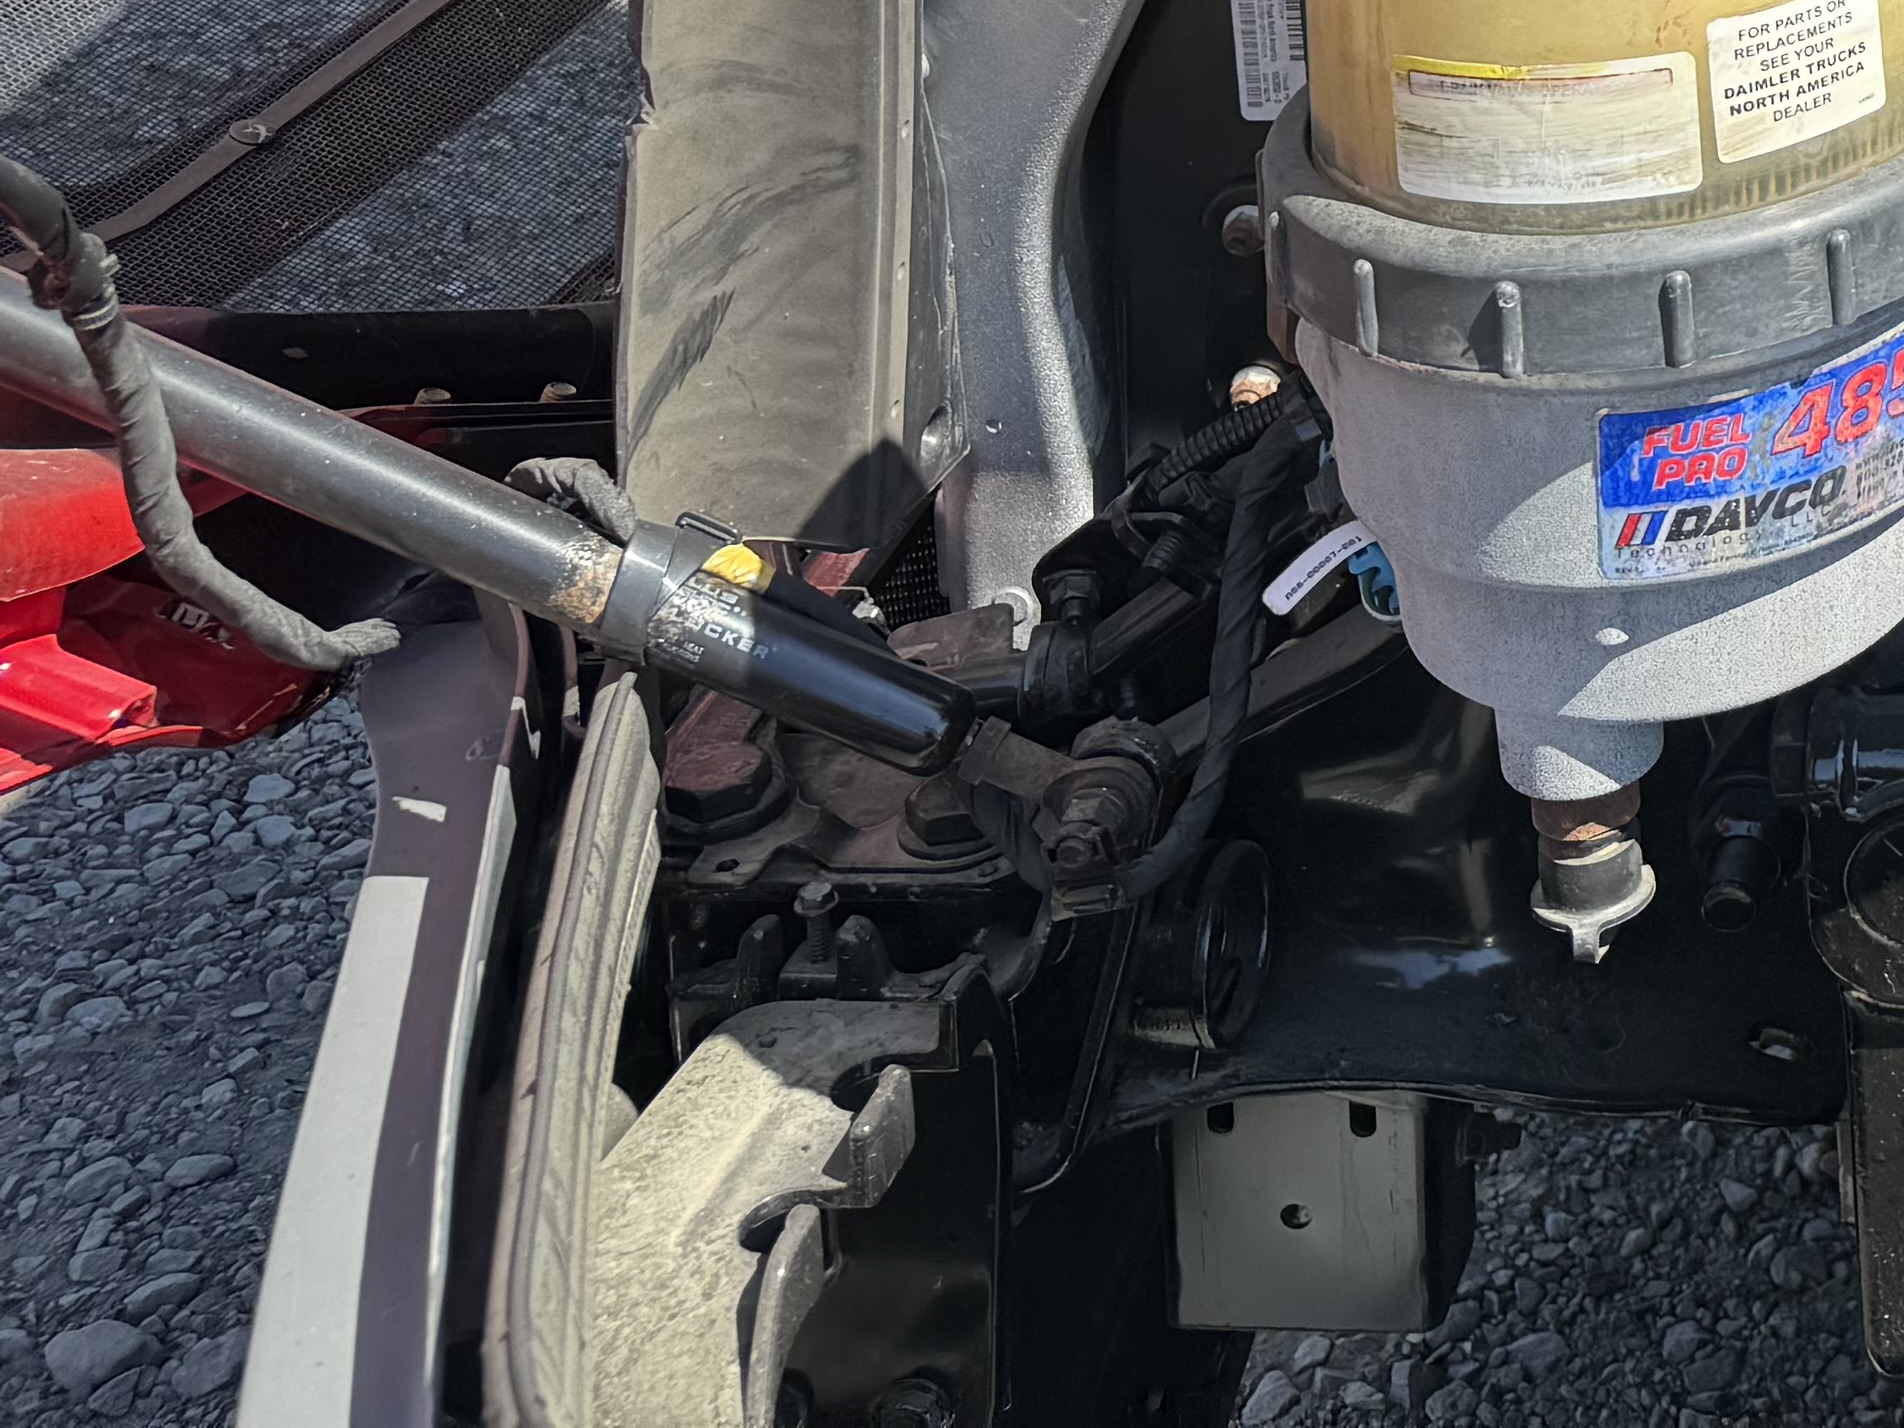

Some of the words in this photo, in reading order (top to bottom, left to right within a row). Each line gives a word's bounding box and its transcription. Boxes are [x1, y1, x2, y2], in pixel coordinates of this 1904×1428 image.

[1733, 11, 1854, 61] REPLACEMENTS
[1738, 20, 1771, 43] FOR
[1775, 5, 1822, 34] PARTS
[1723, 63, 1801, 100] DAIMLER
[1804, 41, 1868, 77] TRUCKS
[1760, 53, 1792, 72] SEE
[1794, 36, 1836, 65] YOUR
[1729, 89, 1791, 117] NORTH
[1795, 62, 1867, 100] AMERICA
[1772, 92, 1832, 124] DEALER
[1641, 411, 1753, 458] FUEL
[1653, 448, 1748, 491] PRO
[1665, 465, 1847, 543] DAVCO
[1616, 530, 1763, 560] Technology
